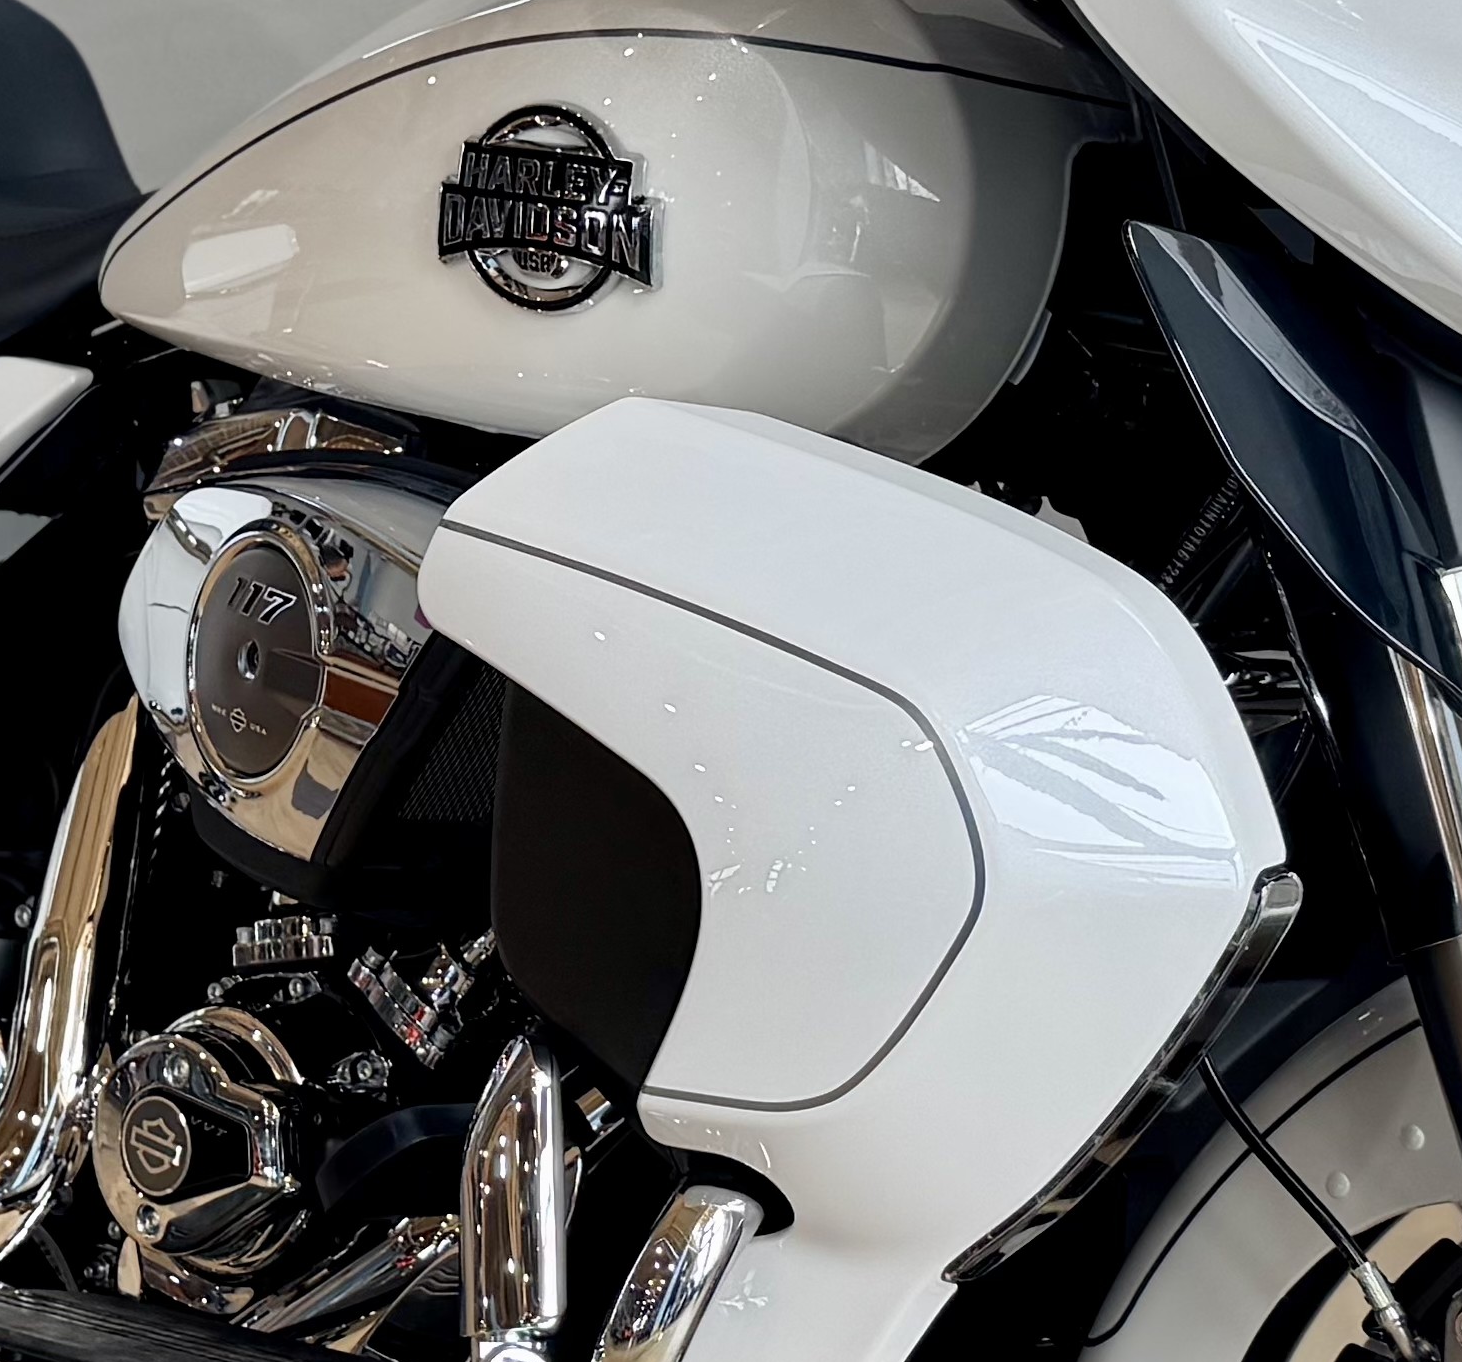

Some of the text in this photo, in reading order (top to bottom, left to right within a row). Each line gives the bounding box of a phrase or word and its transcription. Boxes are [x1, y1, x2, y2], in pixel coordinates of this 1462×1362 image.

[443, 193, 641, 273] DAVIDSON
[227, 577, 297, 625] 117
[190, 1115, 228, 1137] VVT
